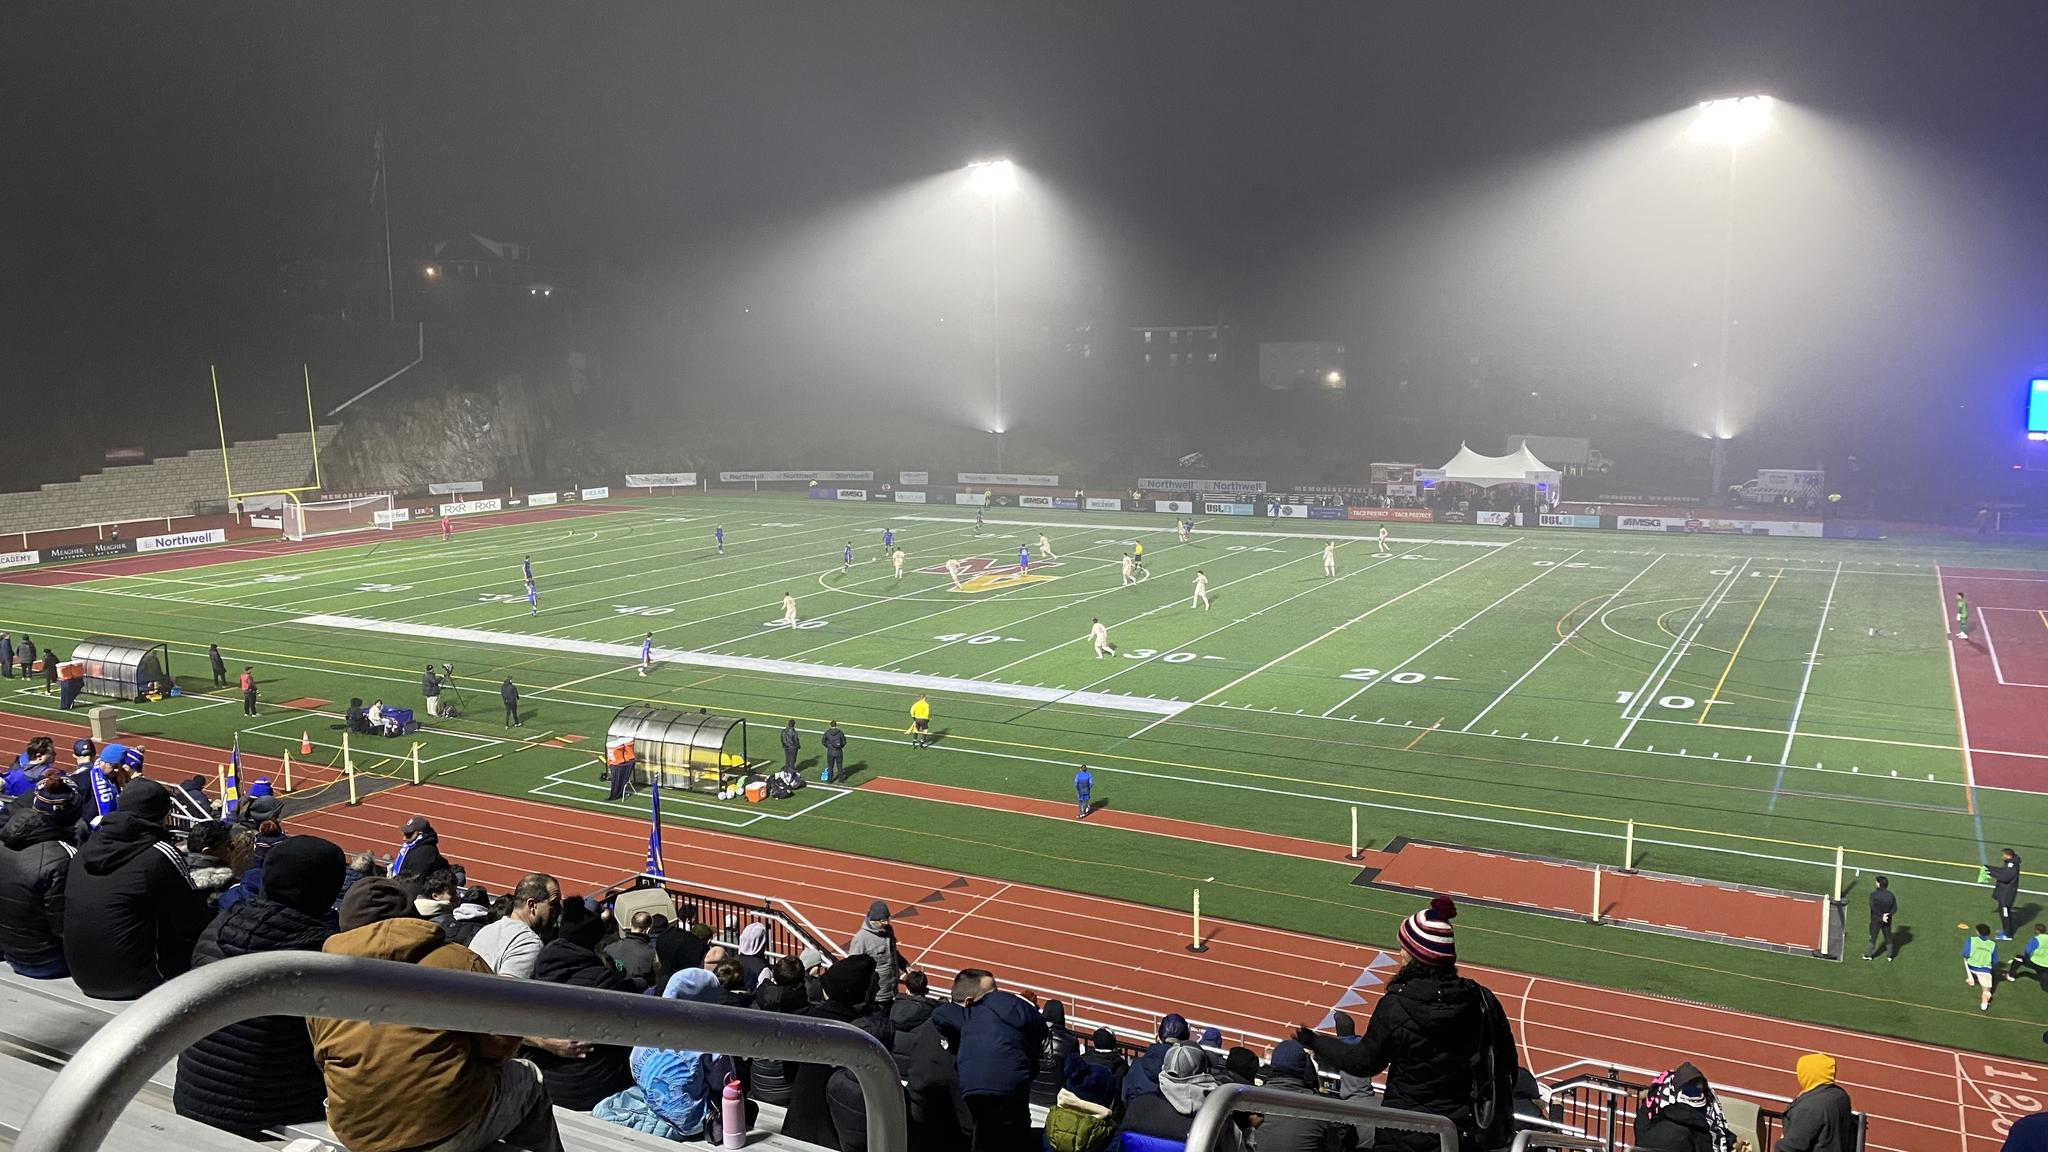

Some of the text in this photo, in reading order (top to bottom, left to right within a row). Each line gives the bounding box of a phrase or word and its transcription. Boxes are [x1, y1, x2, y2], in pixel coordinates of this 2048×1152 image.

[1147, 480, 1262, 491] Northwell Northwell
[444, 501, 496, 514] RXR RXR
[155, 532, 212, 548] Northwell
[933, 633, 1002, 645] 40
[1122, 649, 1197, 663] 30
[1339, 668, 1427, 685] 20
[1616, 691, 1696, 709] 10
[1984, 1065, 2038, 1081] 1
[1987, 1089, 2043, 1112] 2
